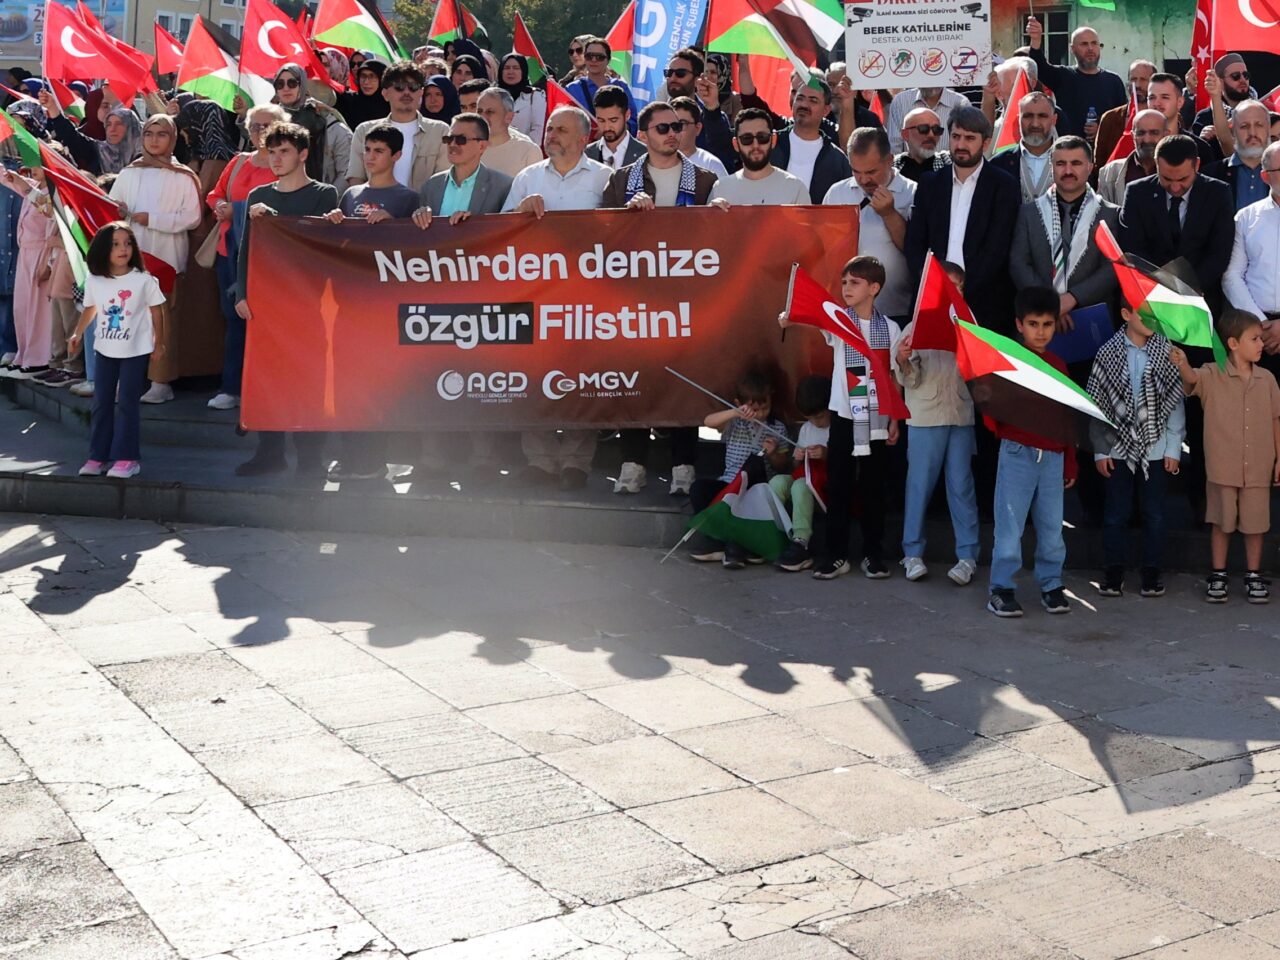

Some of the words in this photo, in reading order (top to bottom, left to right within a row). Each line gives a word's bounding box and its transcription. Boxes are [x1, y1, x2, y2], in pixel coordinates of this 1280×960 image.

[863, 25, 899, 35] BEBEK
[902, 20, 972, 34] KATİLLERİNE
[871, 36, 902, 44] DESTEK
[903, 35, 935, 43] OLMAYI
[936, 34, 964, 42] BIRAK!
[374, 246, 568, 282] Nehirden
[578, 241, 720, 279] denize
[101, 327, 130, 341] Stitch
[405, 305, 530, 350] özgür
[539, 301, 691, 340] Filistin!
[467, 371, 528, 392] AGD
[578, 371, 640, 390] MGV
